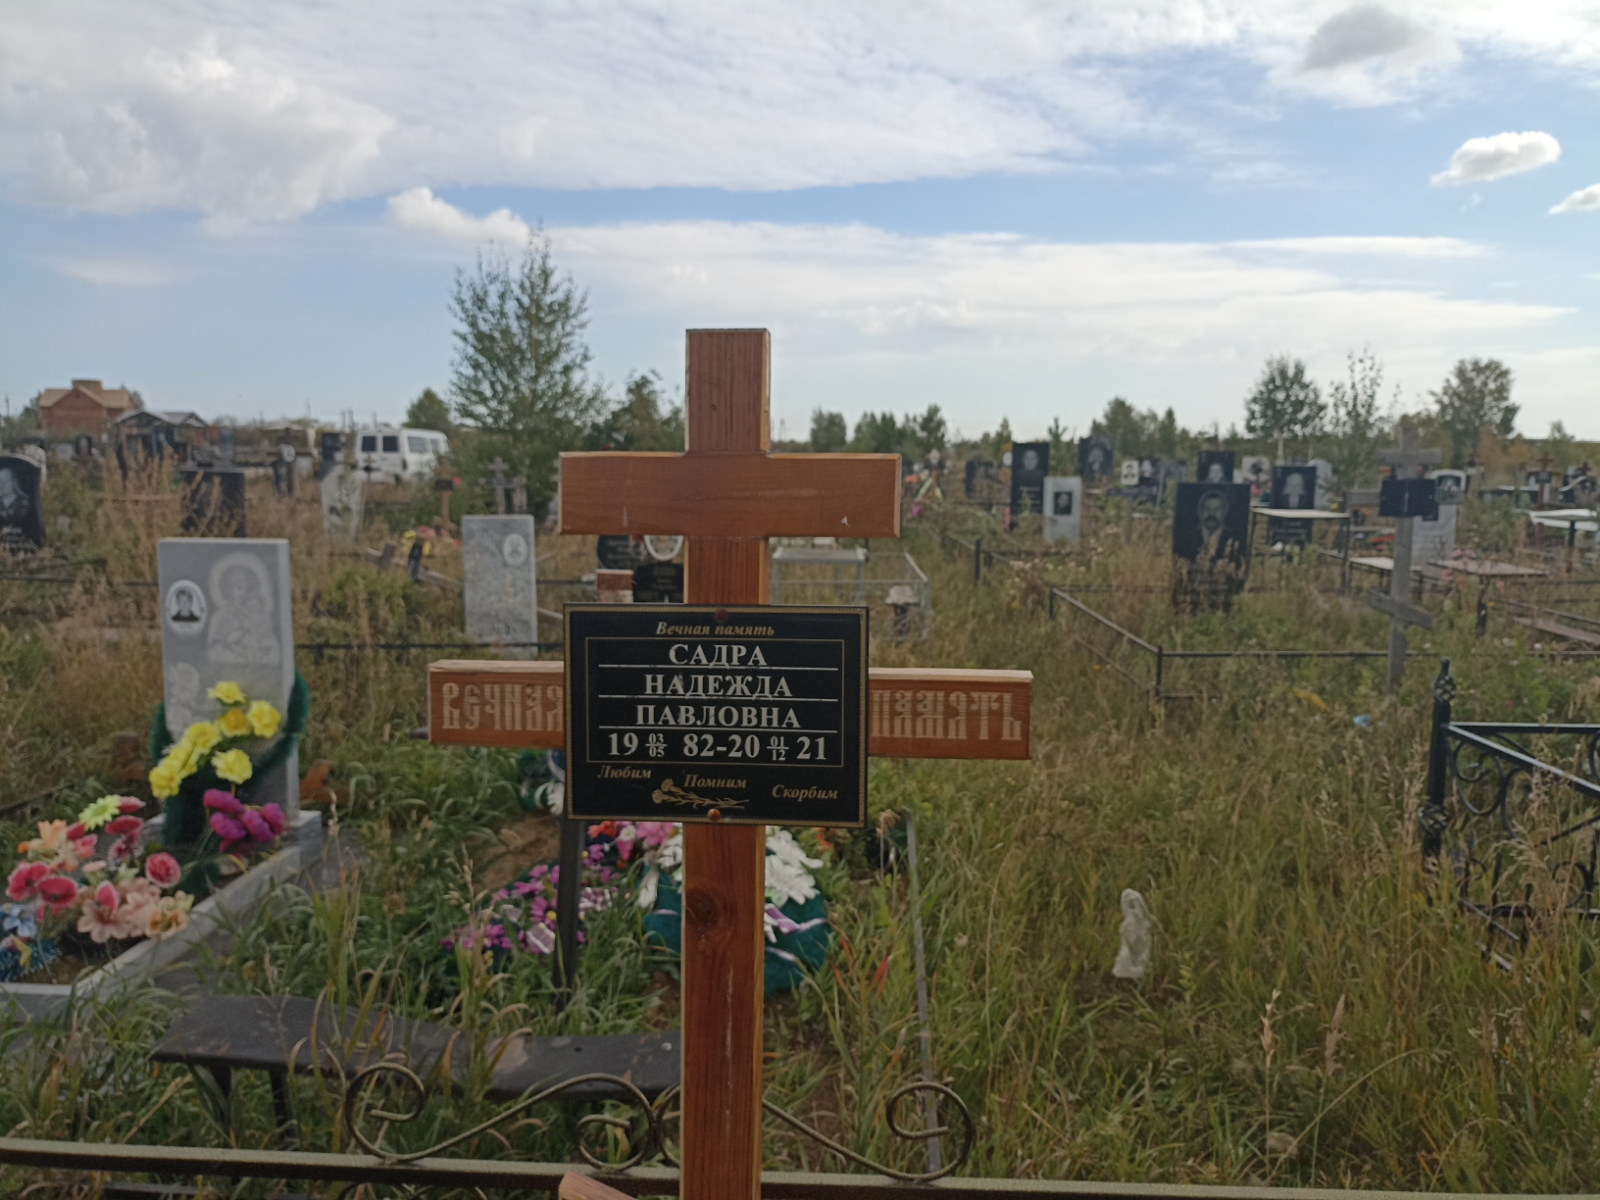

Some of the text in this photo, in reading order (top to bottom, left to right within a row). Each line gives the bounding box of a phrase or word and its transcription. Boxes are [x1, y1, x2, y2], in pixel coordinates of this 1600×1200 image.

[656, 621, 775, 637] Вечная память
[668, 643, 768, 669] САДРА
[644, 673, 793, 699] НАДЕЖДА
[442, 682, 1022, 741] ВЕЧНАЯ ПАМЯТЬ
[635, 704, 801, 728] ПАВЛОВНА
[608, 732, 639, 756] 19
[796, 735, 827, 760] 21
[598, 765, 652, 780] Любим
[683, 774, 747, 789] Помним
[772, 785, 838, 802] Скорбим
